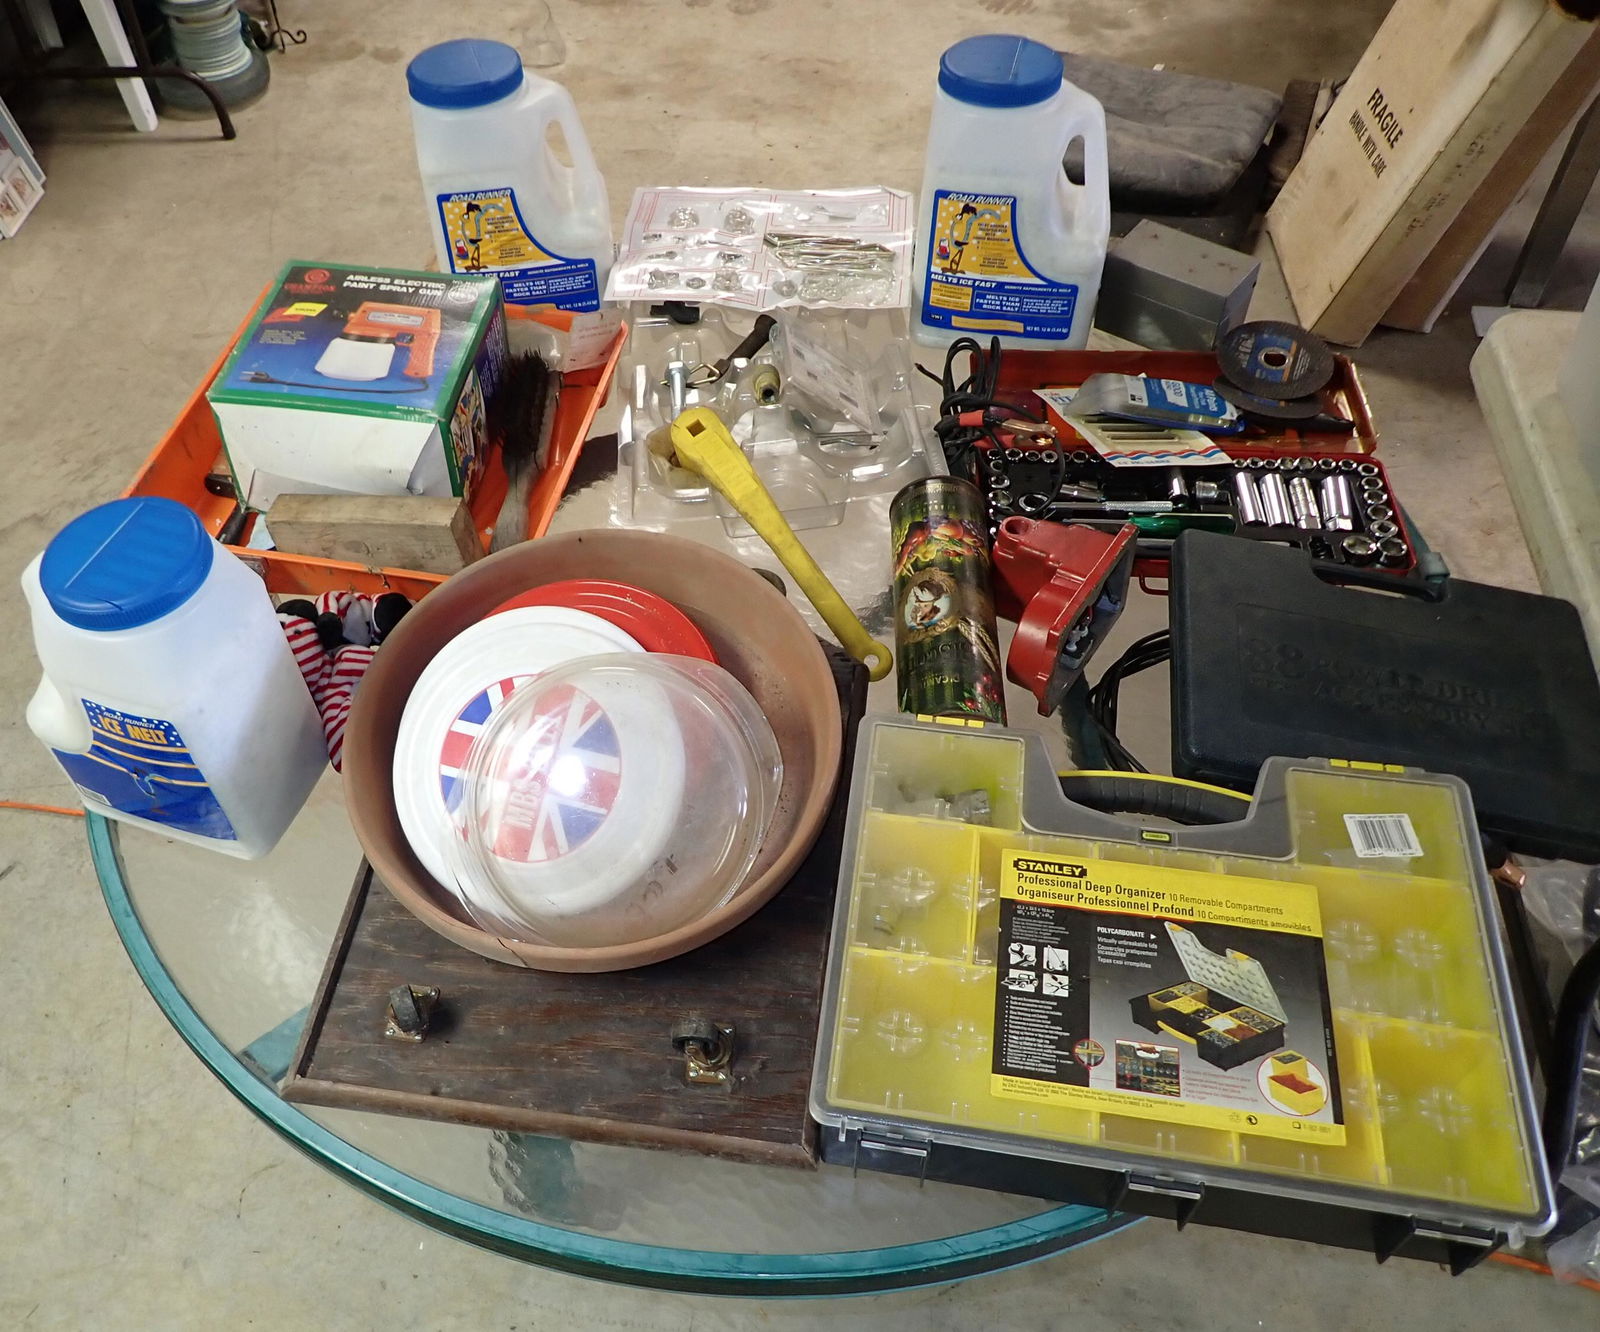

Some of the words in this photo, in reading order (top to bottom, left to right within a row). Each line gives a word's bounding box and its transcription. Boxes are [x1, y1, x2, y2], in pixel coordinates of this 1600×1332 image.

[1366, 87, 1403, 150] FRAGILE
[1348, 109, 1368, 142] HANDLE
[1362, 133, 1378, 161] WITH
[1371, 152, 1387, 179] CARE
[450, 192, 475, 203] ROAD
[476, 188, 512, 200] RUNNER
[947, 192, 975, 203] ROAD
[975, 196, 1014, 206] RUNNER
[343, 281, 376, 290] PAINT
[379, 284, 416, 294] SPRAY
[418, 288, 442, 296] GUN
[346, 274, 391, 284] AIRLESS
[394, 278, 446, 290] ELECTRIC
[930, 274, 958, 284] MELTS
[959, 277, 974, 286] ICE
[974, 280, 997, 288] FAST
[506, 286, 528, 294] FASTER
[976, 298, 1001, 306] FASTER
[103, 711, 123, 722] ROAD
[124, 717, 155, 729] RUNNER
[97, 714, 125, 736] ICE
[126, 724, 168, 745] MELT
[1017, 860, 1082, 876] STANLEY
[1017, 873, 1082, 890] Professional
[1085, 880, 1112, 895] Deep
[1115, 884, 1166, 900] Organizer
[1169, 893, 1178, 901] 10
[1180, 894, 1224, 908] Removable
[1225, 900, 1284, 916] Compartments
[1017, 886, 1074, 903] Organiseur
[1077, 893, 1150, 912] Professionnel
[1152, 903, 1194, 917] Profond
[1198, 910, 1206, 918] 10
[1208, 912, 1269, 927] Compartiments
[1270, 920, 1312, 932] amovibles
[1096, 926, 1145, 938] POLYCARBONATE
[1097, 936, 1118, 945] Virtually
[1118, 939, 1148, 948] unbreakable
